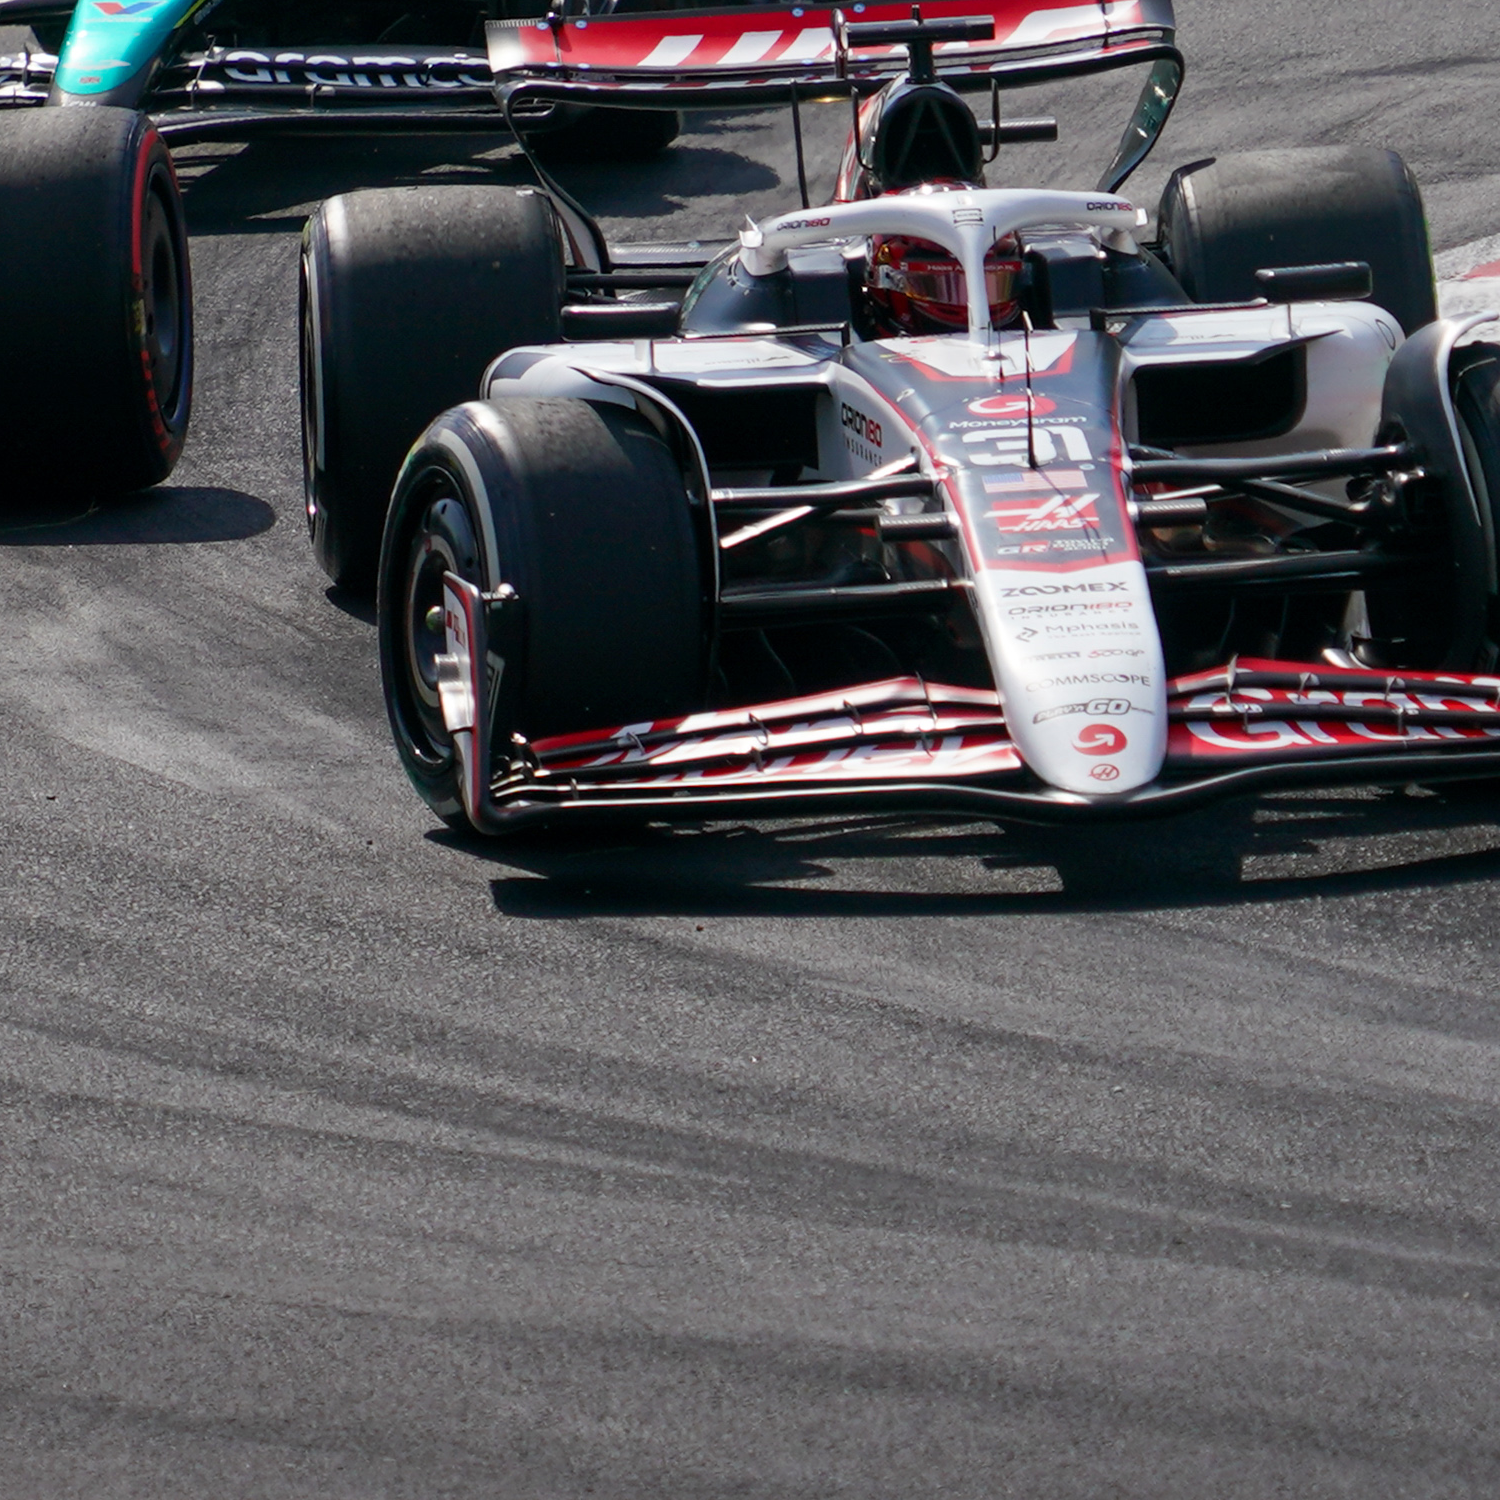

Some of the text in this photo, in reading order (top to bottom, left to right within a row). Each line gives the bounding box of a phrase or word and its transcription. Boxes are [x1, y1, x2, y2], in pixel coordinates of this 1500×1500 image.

[949, 415, 1087, 429] MoneyGram
[962, 425, 1093, 467] 31
[999, 517, 1100, 532] HAAS
[1001, 581, 1129, 598] ZOOMEX
[1008, 601, 1133, 616] ORION180
[1045, 621, 1139, 633] Mphasis
[1025, 673, 1152, 693] COMMSCOPE
[1086, 699, 1132, 716] GO
